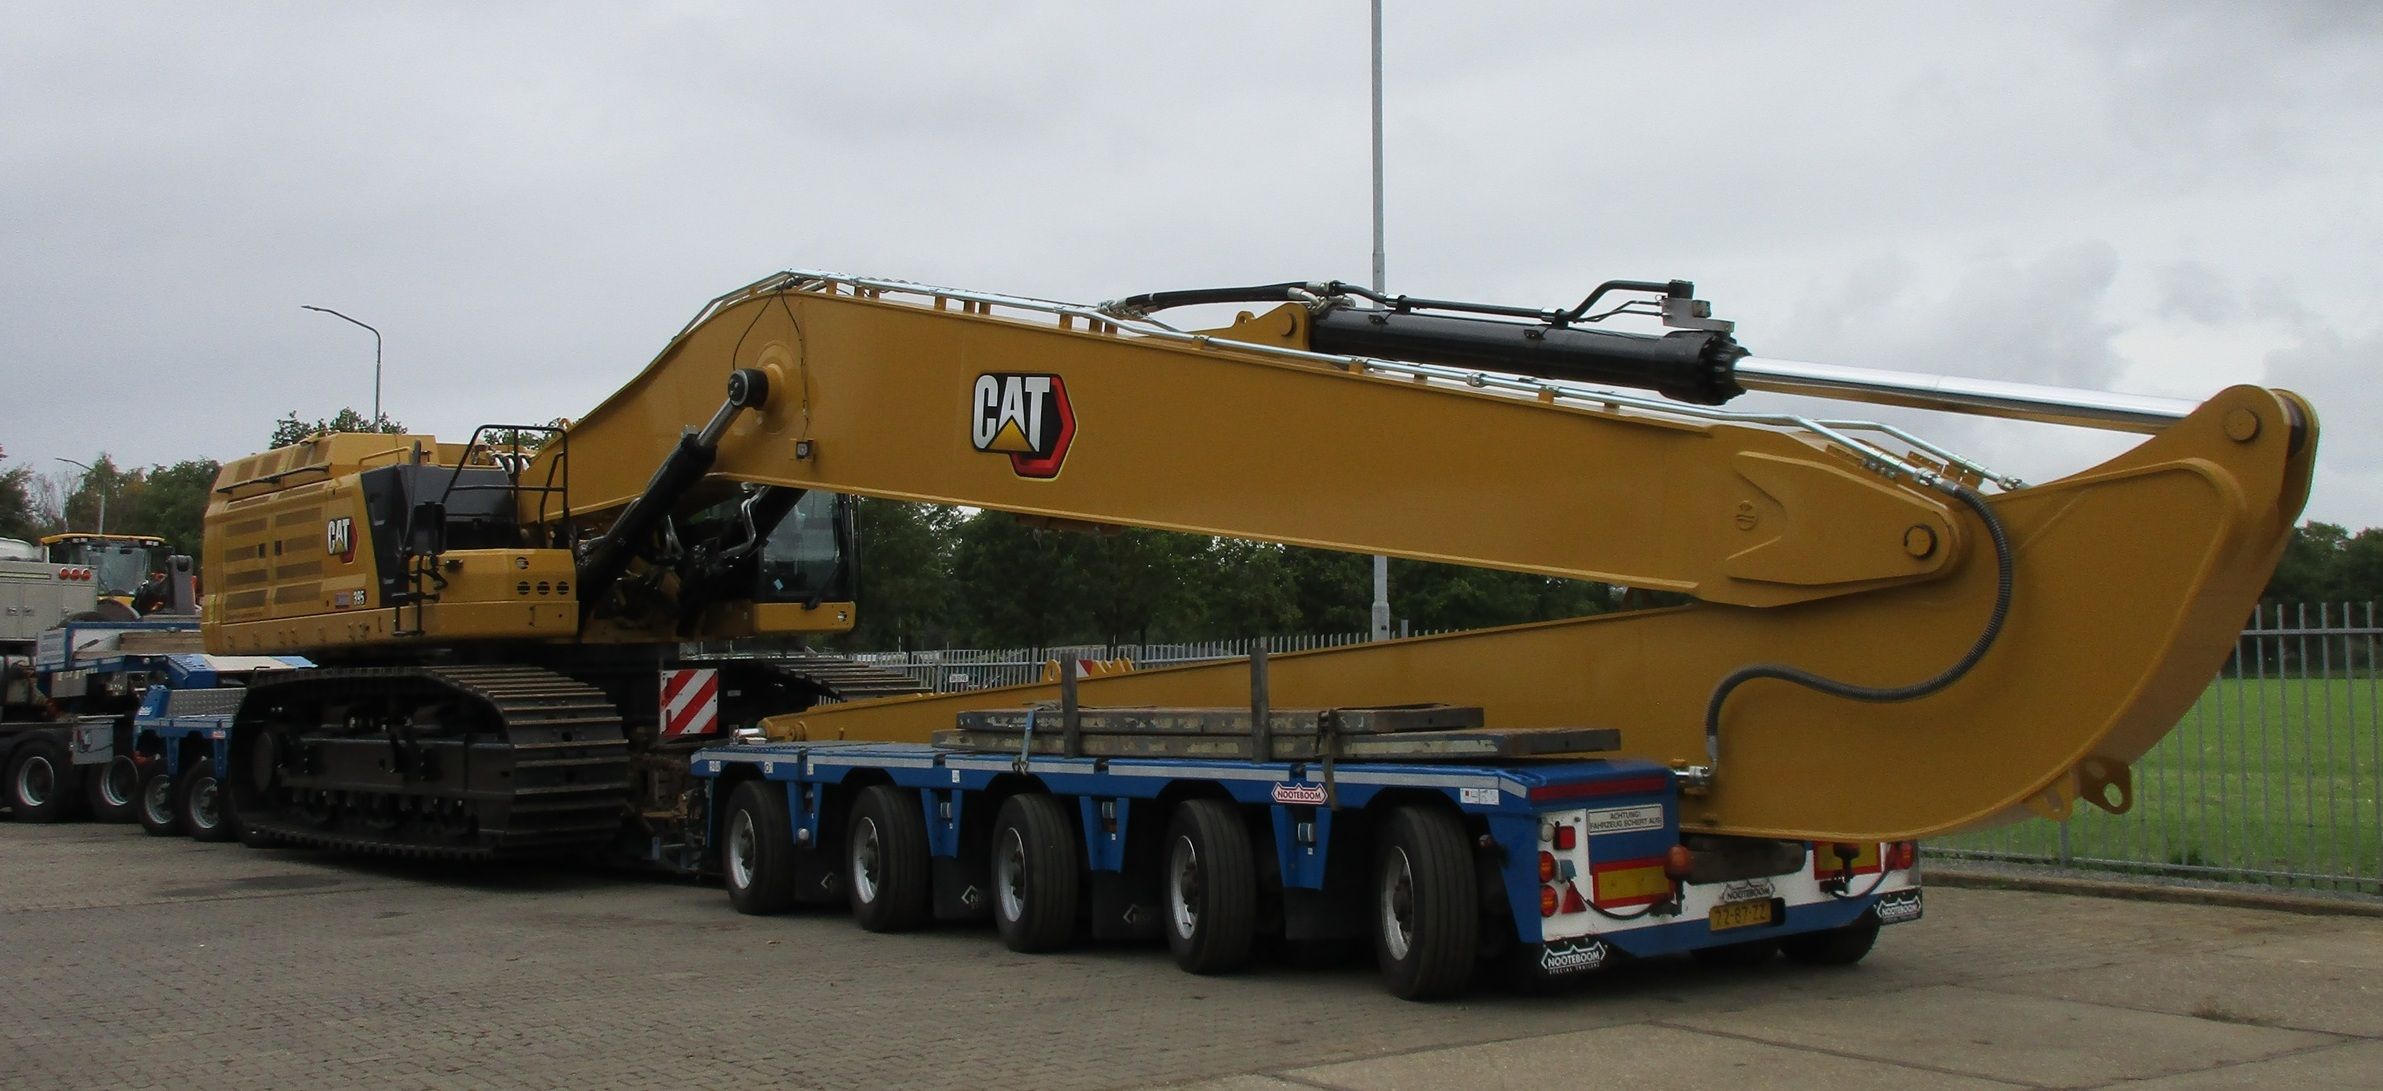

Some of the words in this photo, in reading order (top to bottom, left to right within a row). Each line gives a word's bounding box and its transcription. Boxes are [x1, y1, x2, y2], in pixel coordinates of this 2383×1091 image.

[973, 374, 1051, 453] CAT
[327, 519, 350, 554] CAT
[353, 590, 366, 606] 395
[1277, 790, 1322, 800] NOOTEBOOM
[1590, 820, 1622, 830] FAHRZEUG
[1624, 818, 1648, 827] SCHERT
[1727, 887, 1770, 899] NOOTEBOOM
[1881, 903, 1918, 917] NOOTEBOOM
[1547, 950, 1600, 968] NOOTEBOOM
